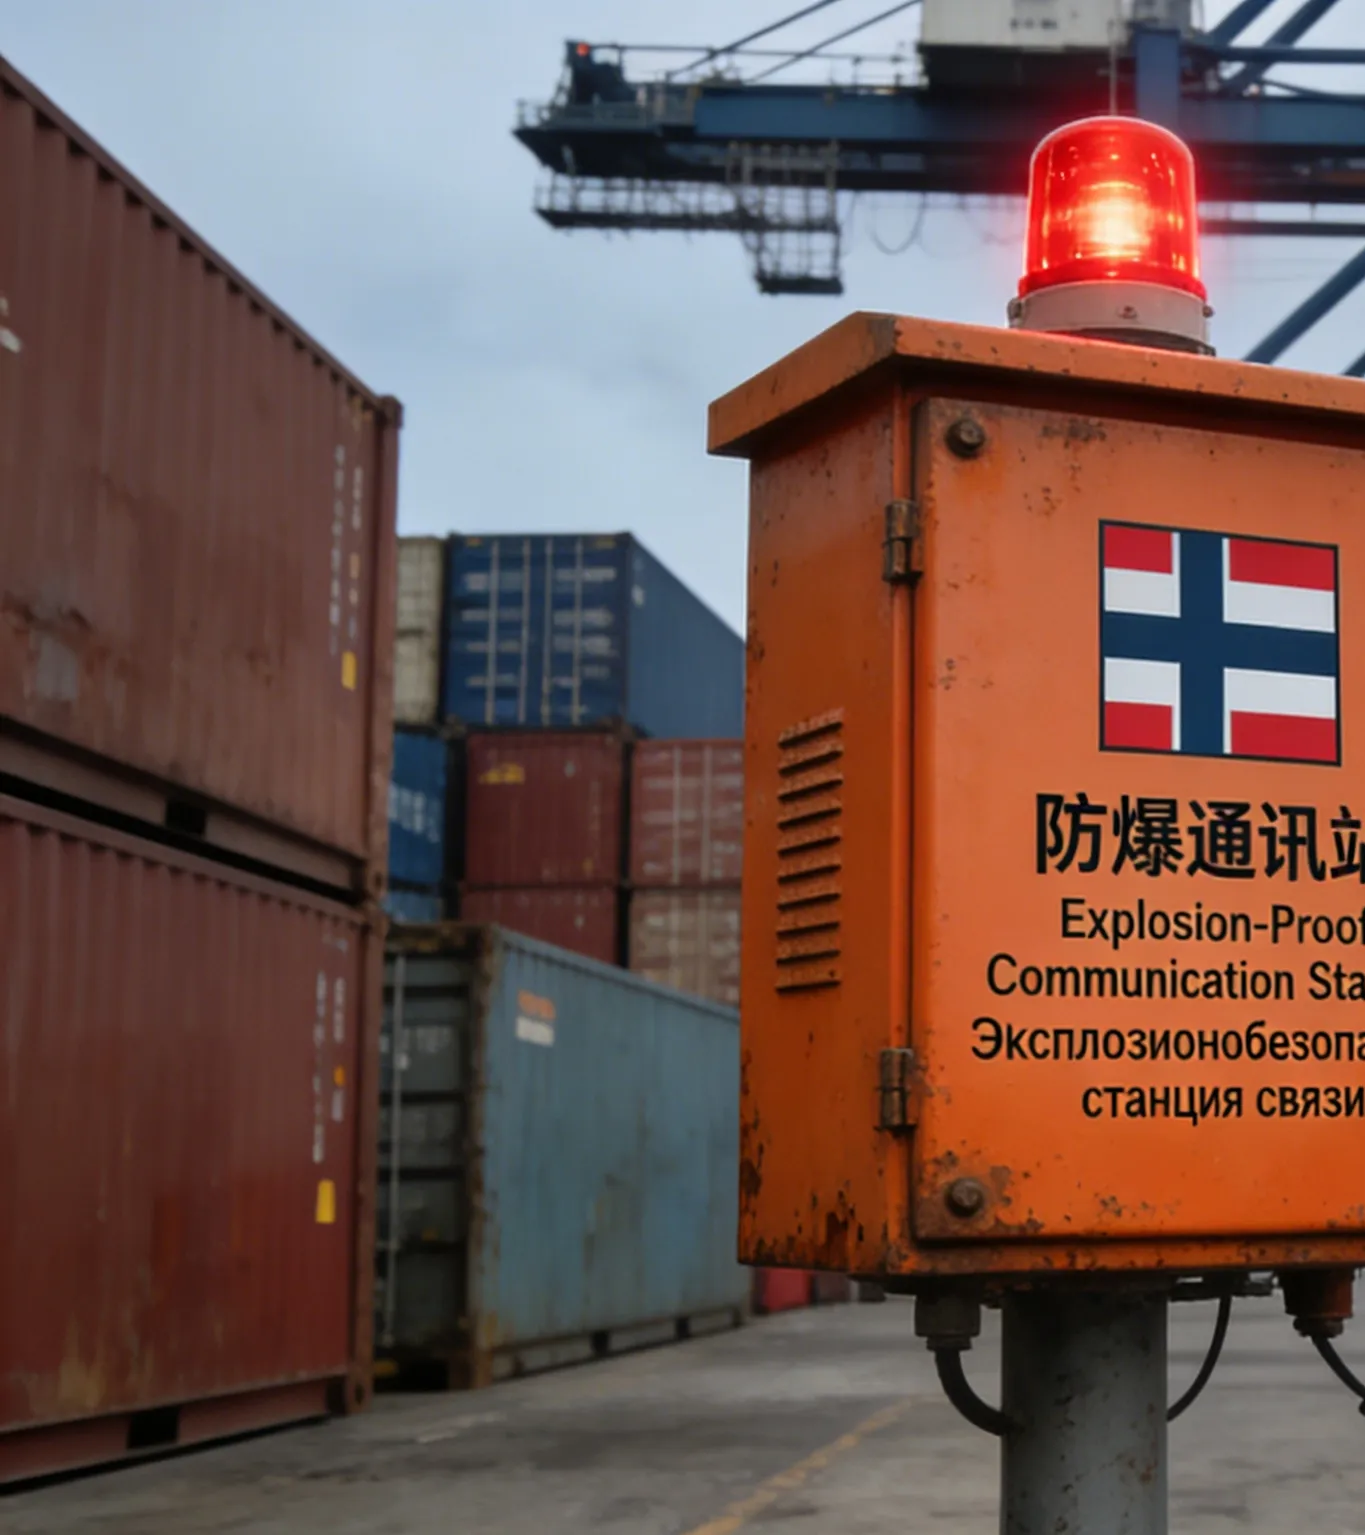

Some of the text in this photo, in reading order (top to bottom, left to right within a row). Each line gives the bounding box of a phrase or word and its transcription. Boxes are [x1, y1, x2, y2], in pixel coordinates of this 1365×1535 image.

[986, 952, 1295, 1001] Communication
[1080, 1085, 1365, 1128] станция связи
